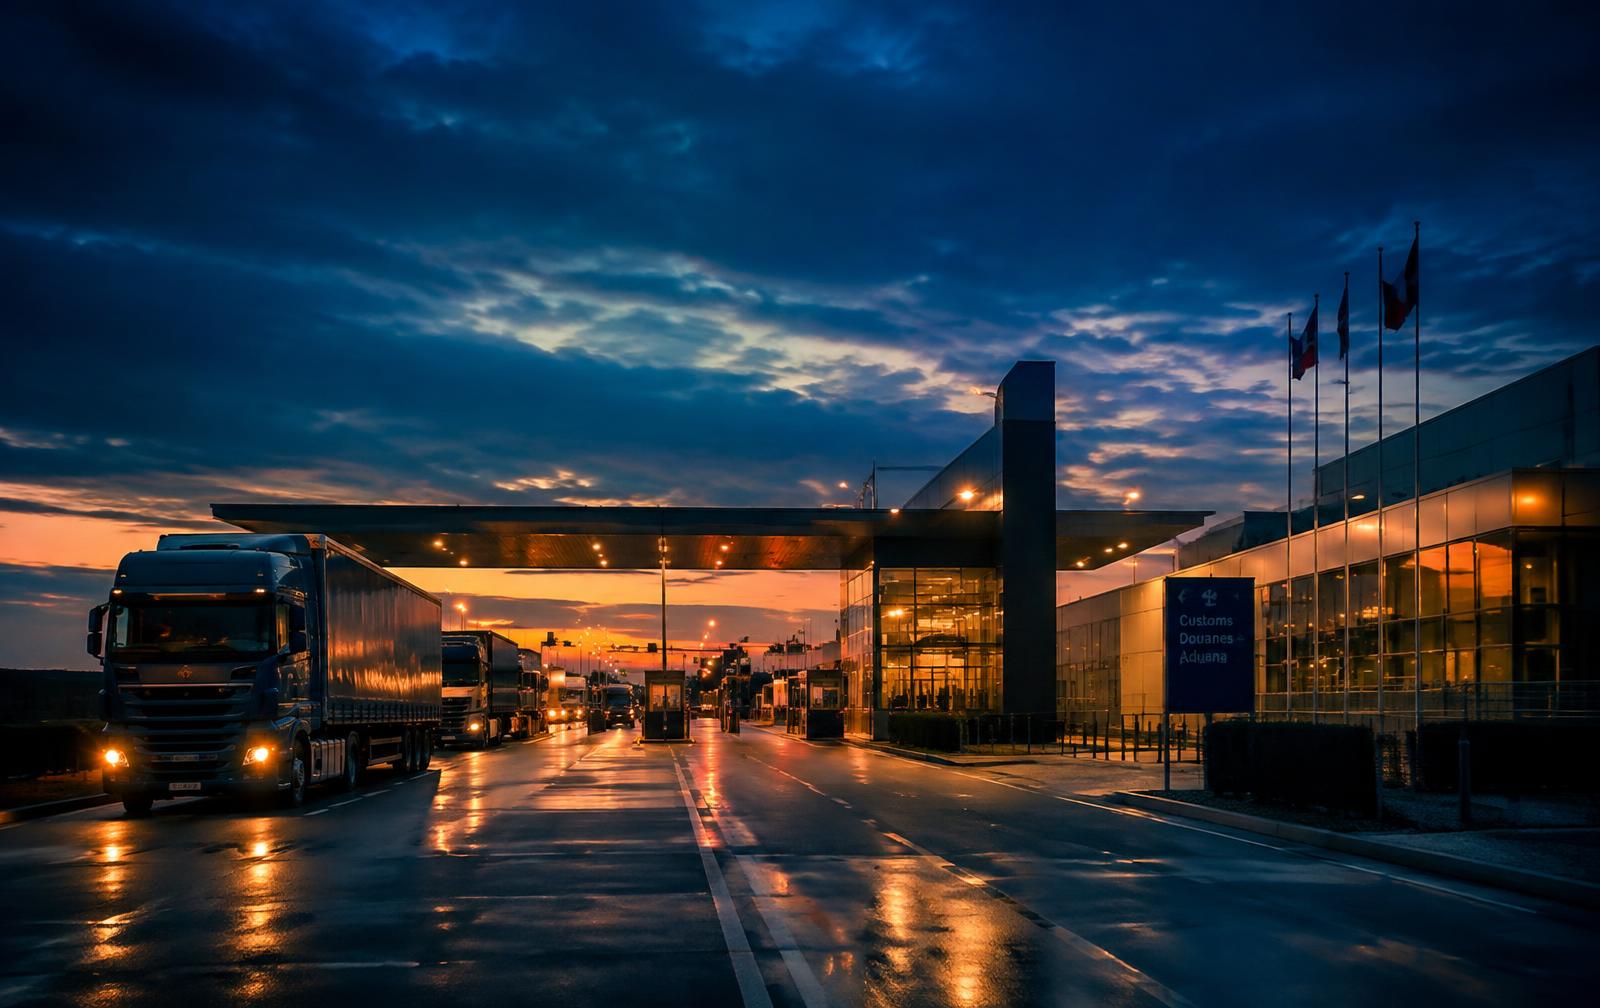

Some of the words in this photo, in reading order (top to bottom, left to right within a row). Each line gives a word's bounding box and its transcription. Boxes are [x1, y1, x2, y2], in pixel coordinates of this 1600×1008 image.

[1179, 614, 1233, 626] Customs
[1179, 632, 1233, 645] Douanes
[1179, 650, 1227, 664] Aduana
